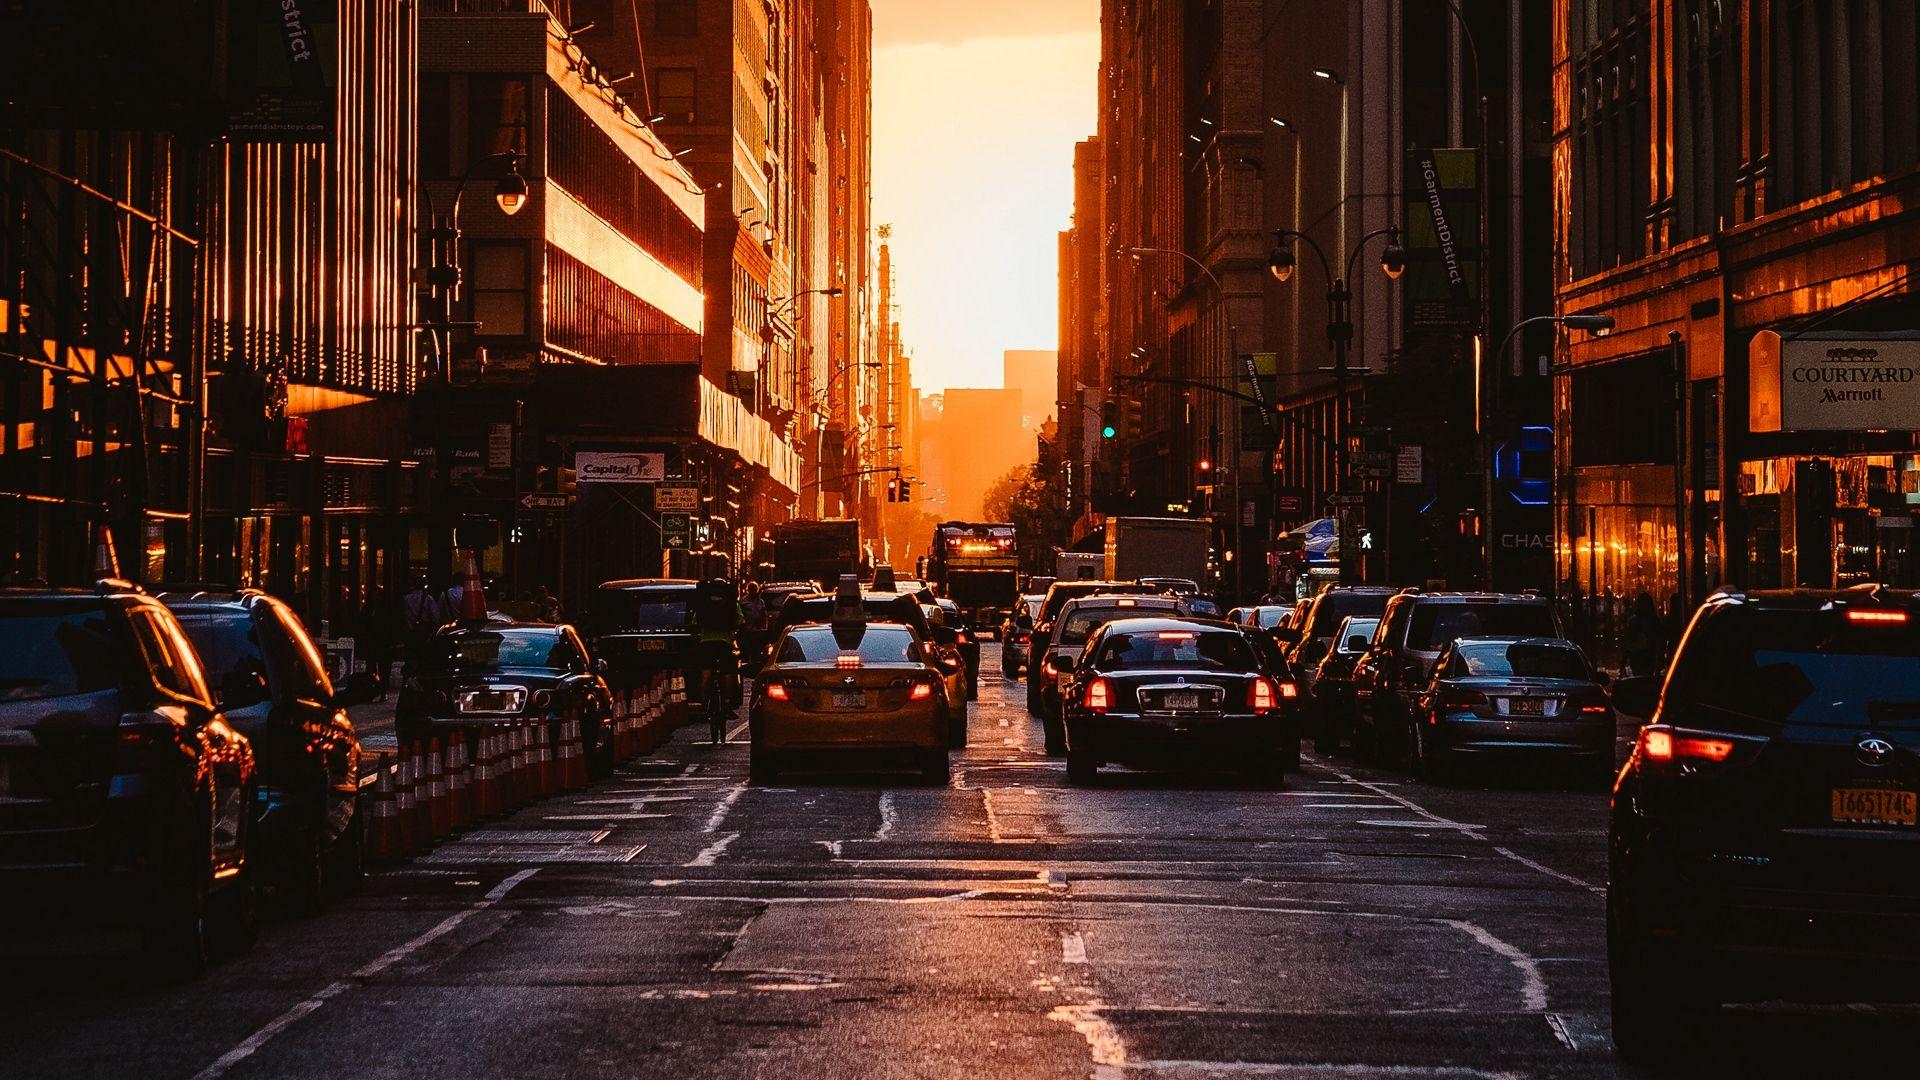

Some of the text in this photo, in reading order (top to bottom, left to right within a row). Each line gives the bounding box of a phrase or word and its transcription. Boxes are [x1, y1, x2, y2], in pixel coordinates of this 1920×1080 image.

[1421, 159, 1462, 286] #GarmentDistrict
[1792, 367, 1914, 383] COURTYARD
[1820, 388, 1883, 404] Marriott
[1838, 790, 1912, 818] T665174C
